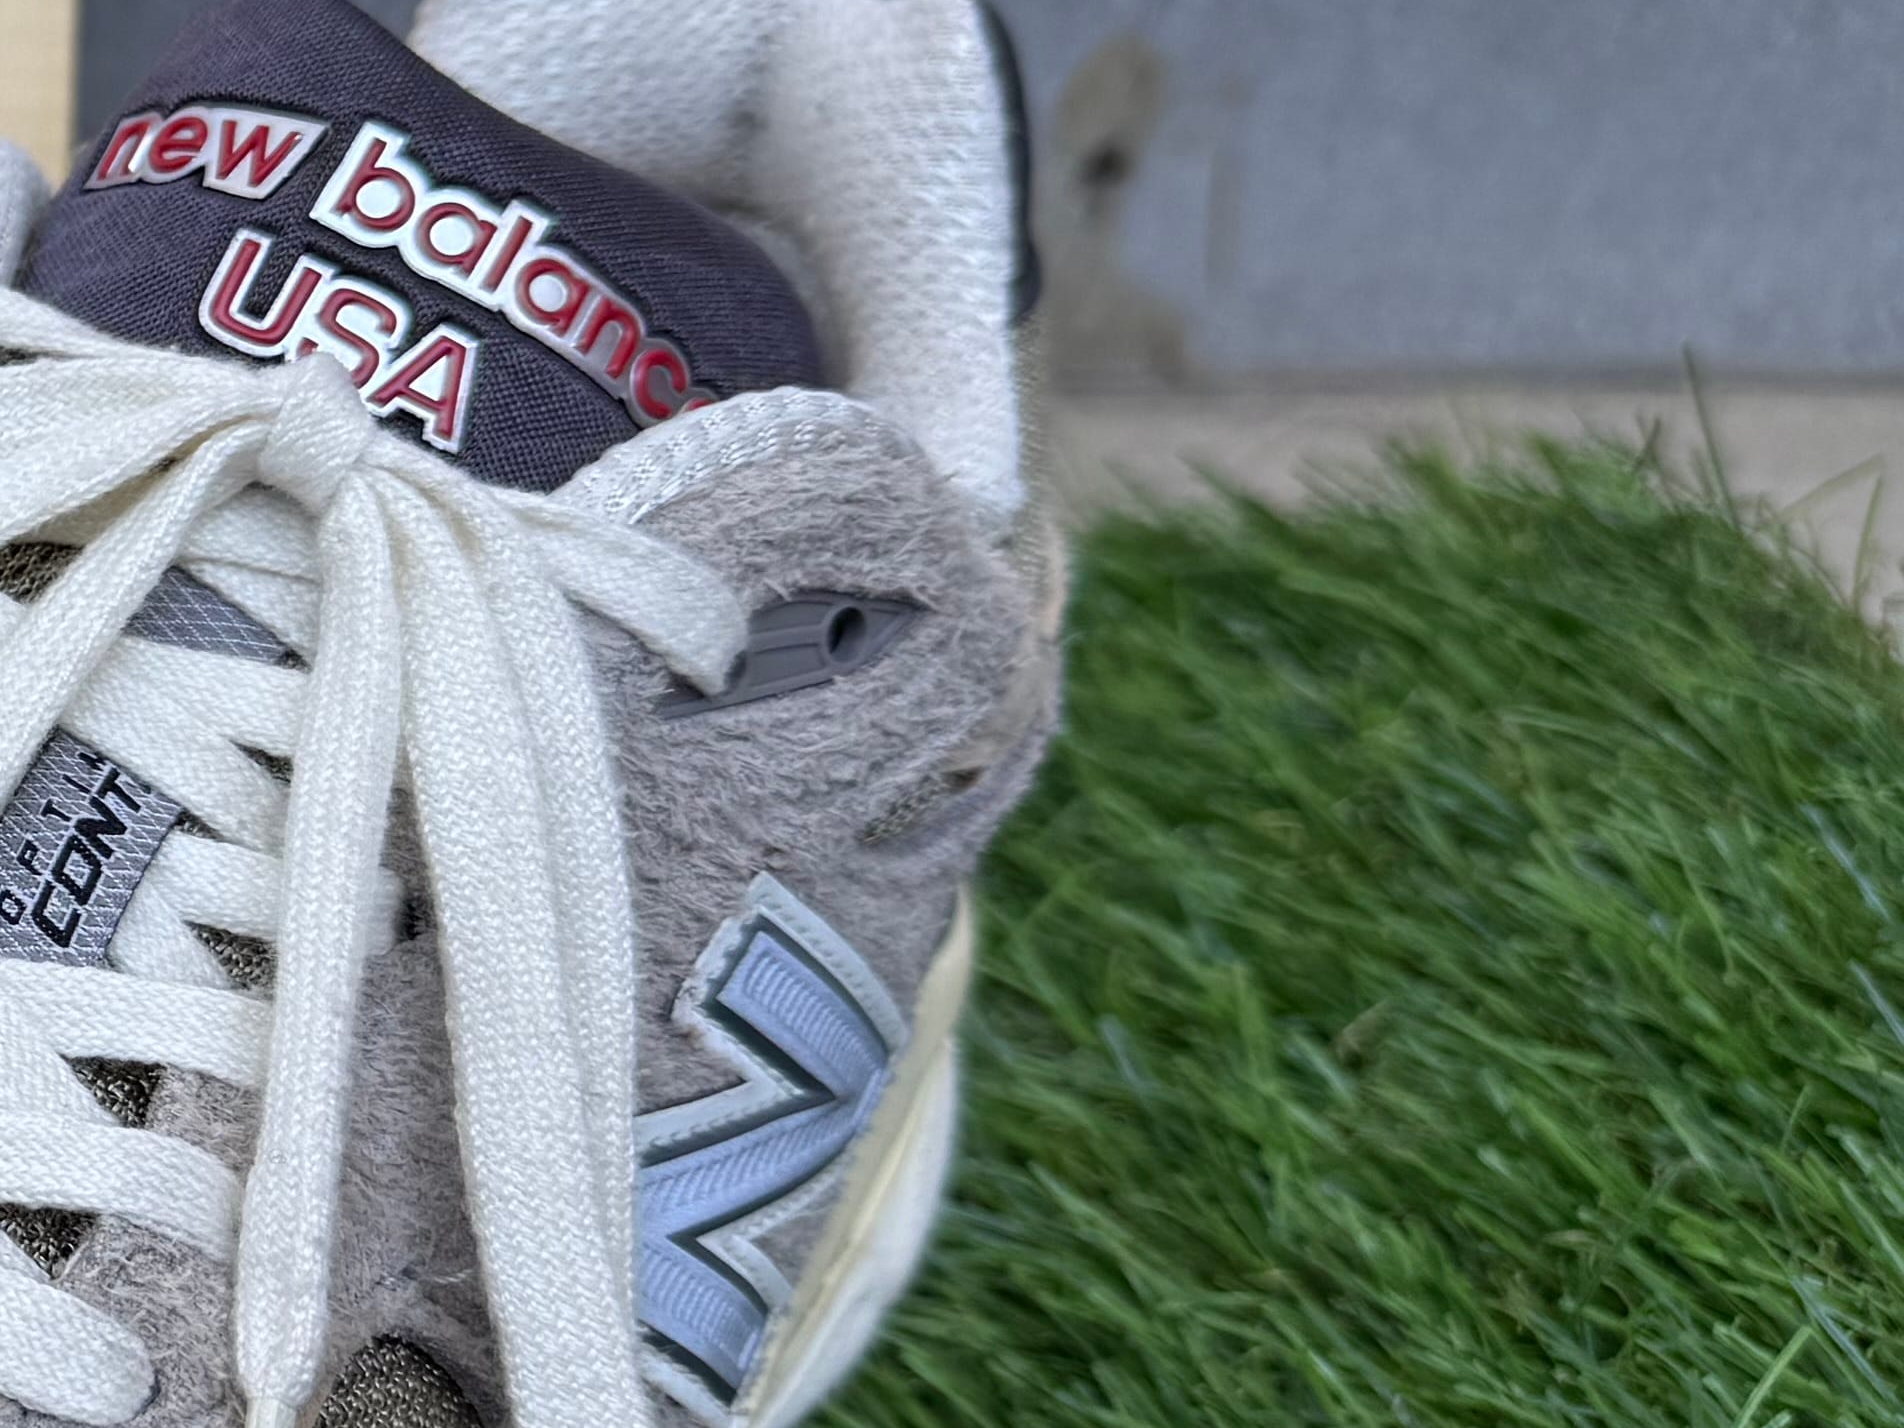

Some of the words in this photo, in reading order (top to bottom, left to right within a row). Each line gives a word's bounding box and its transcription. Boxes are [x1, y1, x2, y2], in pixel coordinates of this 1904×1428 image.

[87, 104, 324, 198] new
[312, 124, 720, 425] balanc
[201, 230, 478, 452] USA
[29, 768, 154, 947] CONT
